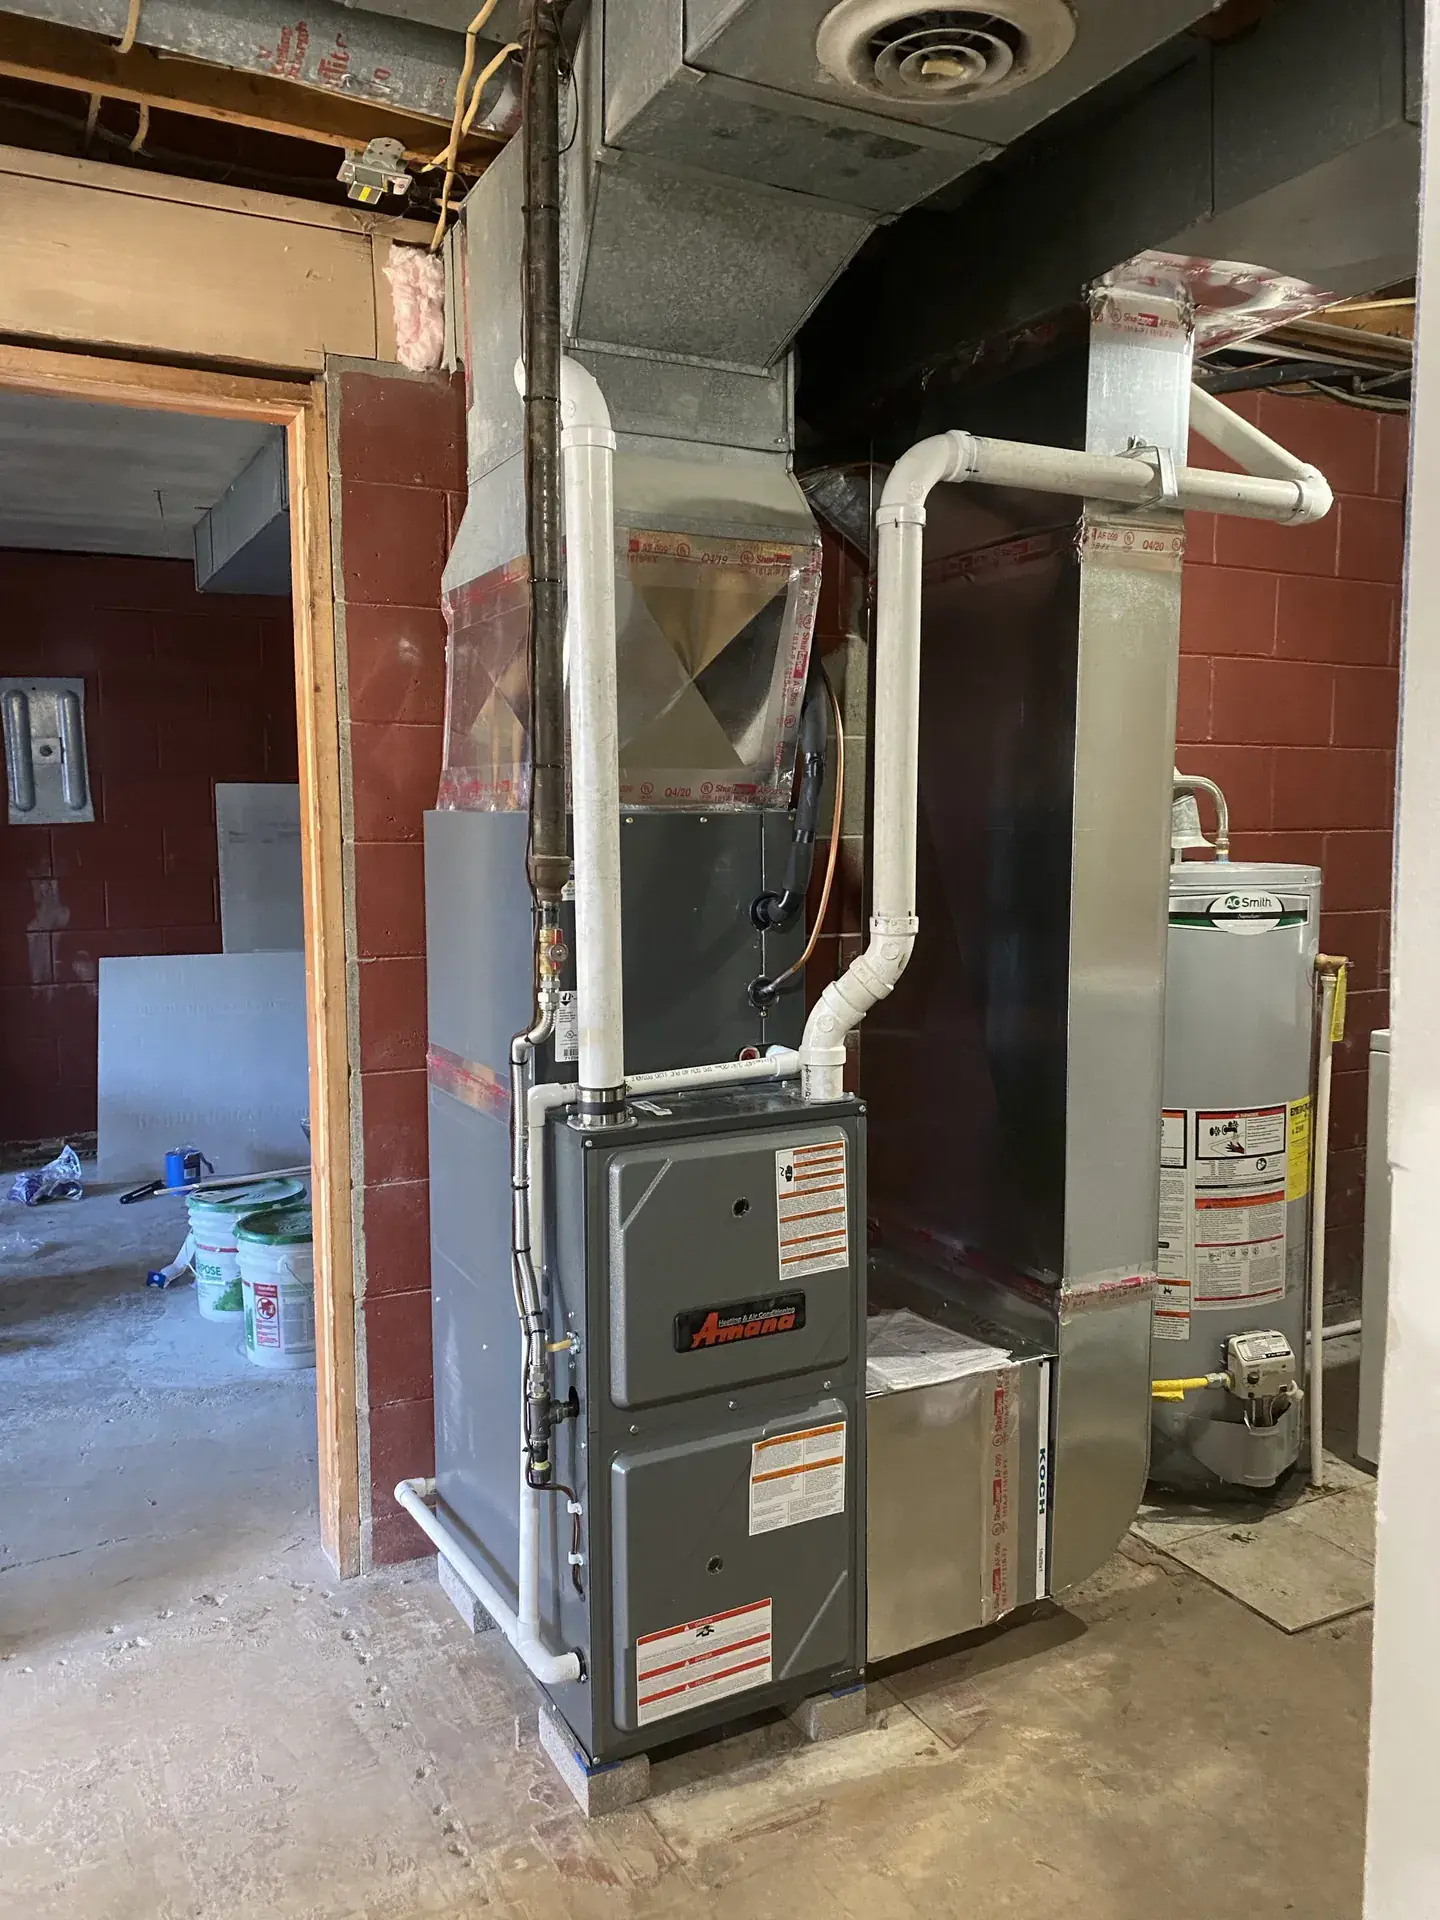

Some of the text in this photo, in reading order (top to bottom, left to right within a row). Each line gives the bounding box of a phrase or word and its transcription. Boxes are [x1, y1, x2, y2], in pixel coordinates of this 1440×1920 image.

[1143, 540, 1164, 551] Q4/20
[701, 553, 728, 565] Q4/19
[664, 787, 692, 798] Q4/20
[748, 1313, 758, 1321] Air
[758, 1307, 796, 1319] Conditioning
[690, 1311, 796, 1348] Amana
[1038, 1447, 1046, 1514] KOCH
